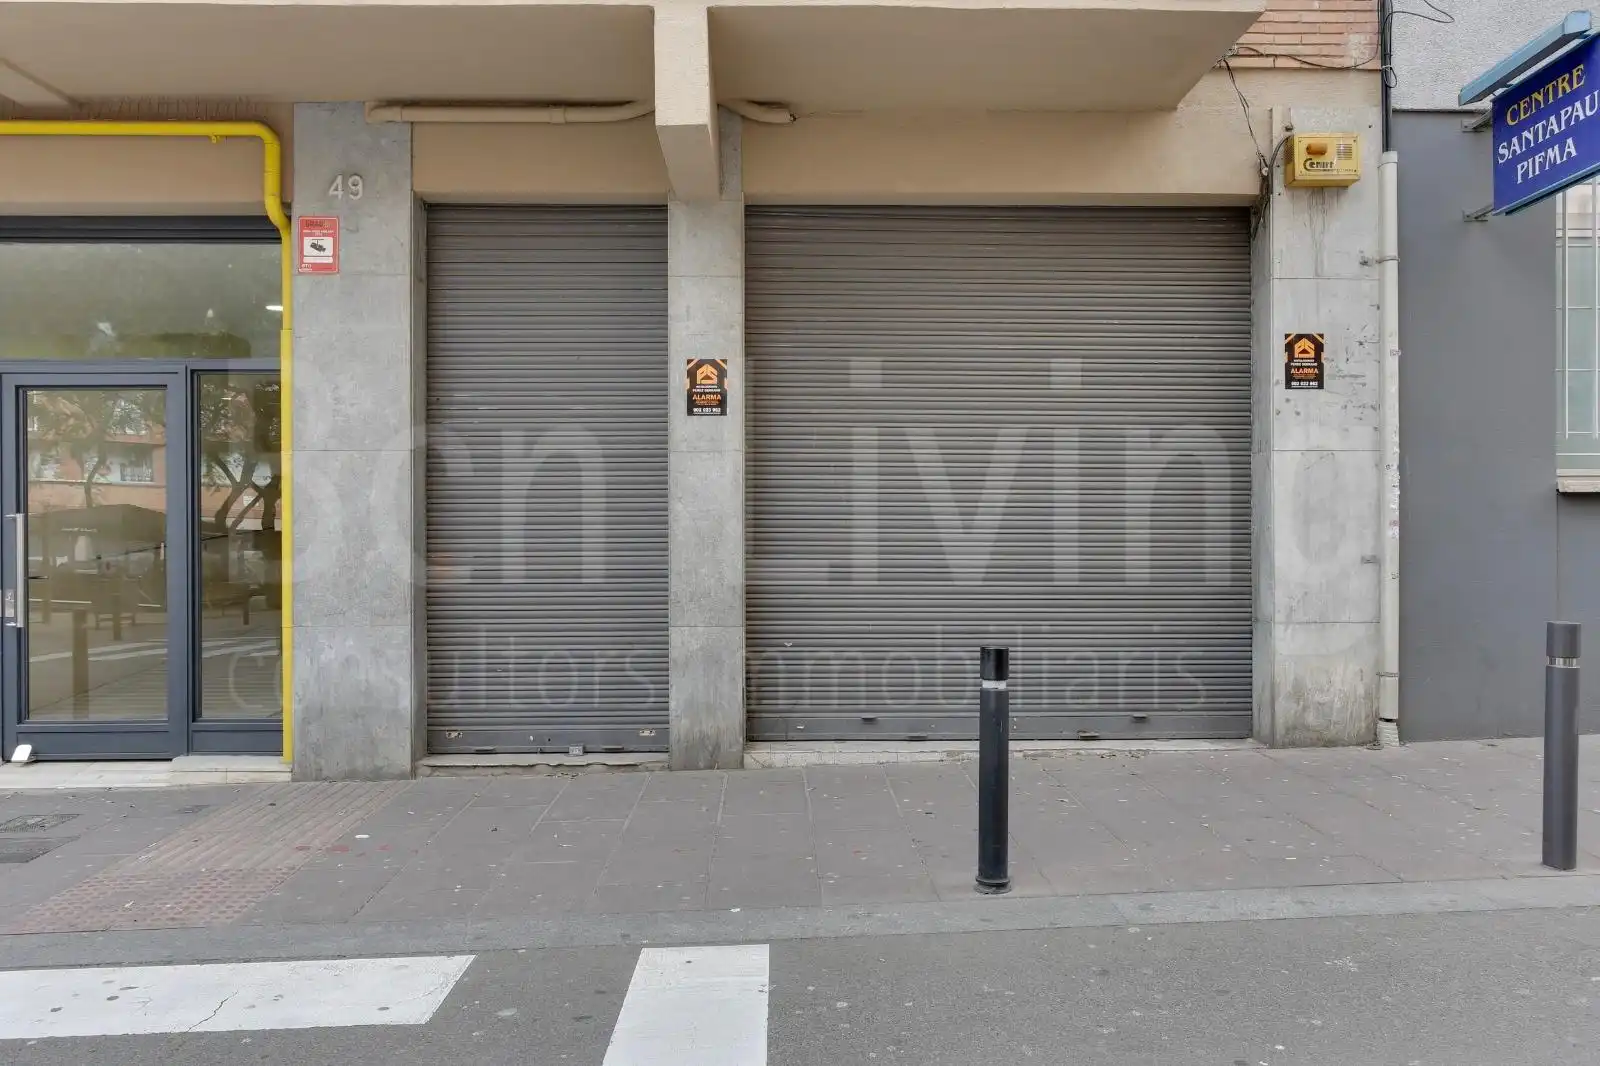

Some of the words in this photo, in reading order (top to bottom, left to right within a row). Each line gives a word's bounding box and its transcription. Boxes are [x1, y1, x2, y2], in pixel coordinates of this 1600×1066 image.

[1506, 64, 1586, 126] CENTRE
[1498, 89, 1600, 164] SANTAPAU
[329, 174, 363, 200] 49
[1516, 137, 1578, 184] PIFMA
